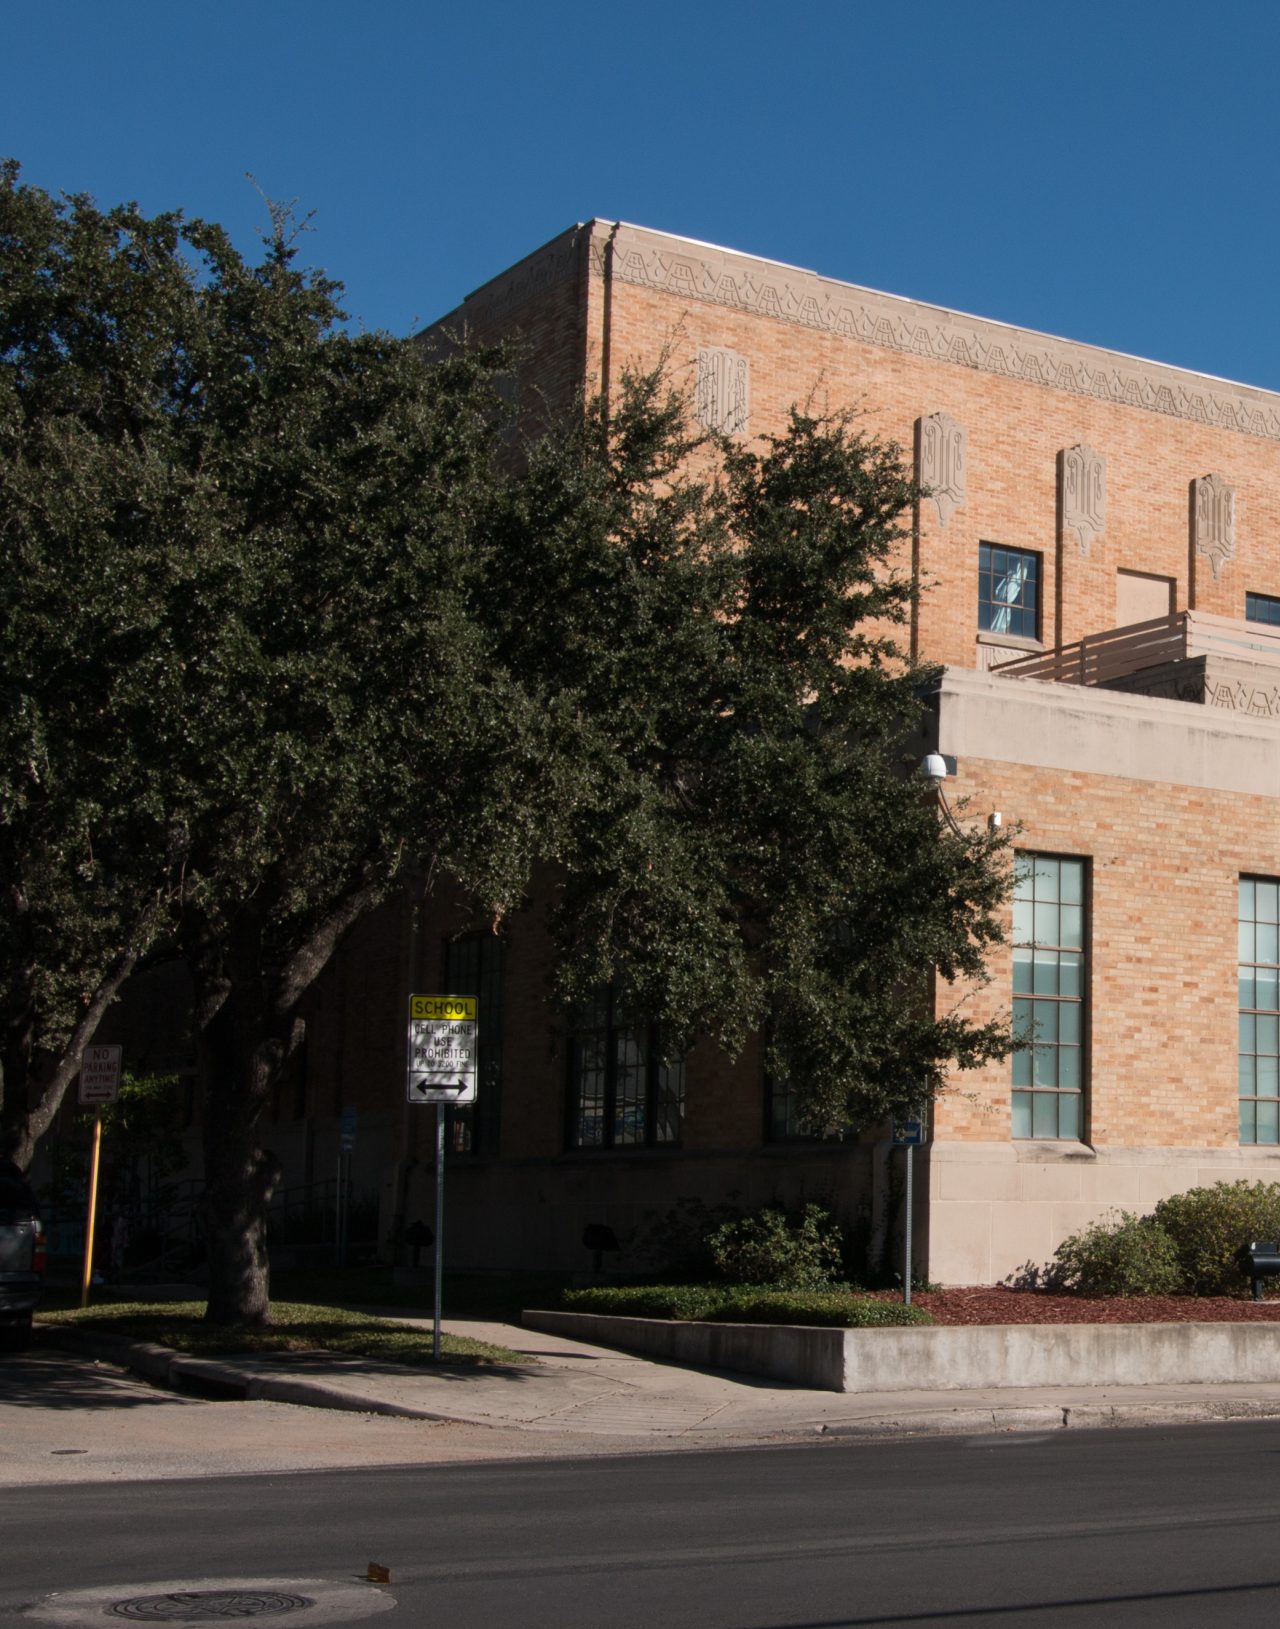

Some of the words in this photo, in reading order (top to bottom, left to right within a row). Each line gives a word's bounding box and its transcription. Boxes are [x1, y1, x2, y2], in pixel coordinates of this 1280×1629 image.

[415, 1001, 472, 1015] SCHOOL
[415, 1024, 436, 1034] CELL
[442, 1024, 472, 1035] PHONE
[434, 1037, 453, 1047] USE
[93, 1049, 110, 1060] NO
[415, 1048, 471, 1059] PROHIBITED
[85, 1062, 119, 1072] PARKING
